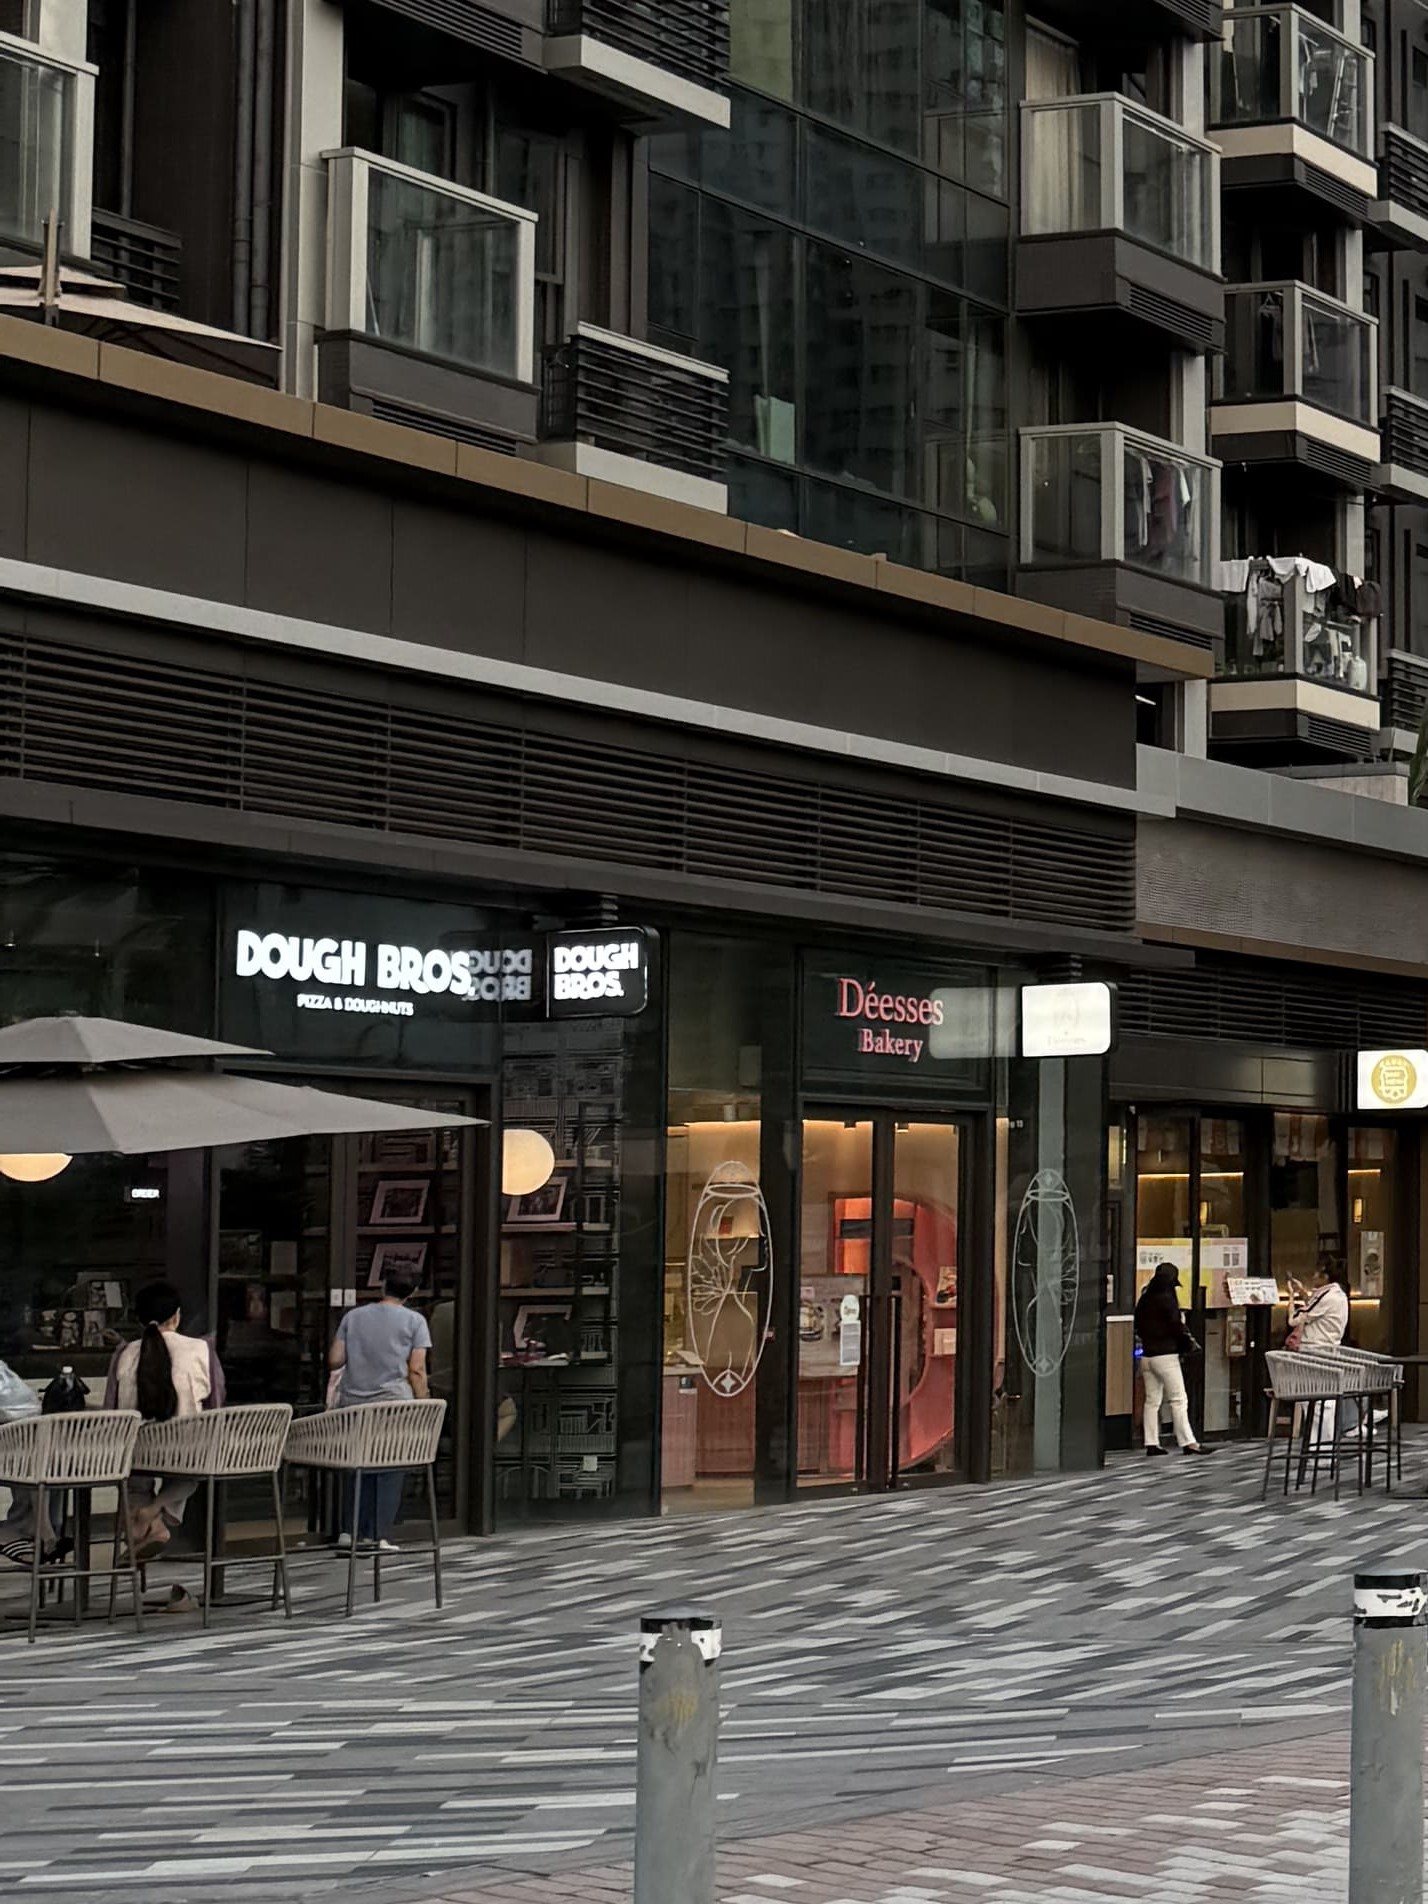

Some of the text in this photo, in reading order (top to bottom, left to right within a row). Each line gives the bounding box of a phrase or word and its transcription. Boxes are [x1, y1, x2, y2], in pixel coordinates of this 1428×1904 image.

[236, 930, 476, 996] DOUGH BROS.
[554, 942, 639, 973] DOUGH
[554, 972, 624, 1000] BROS.
[838, 977, 943, 1025] Déesses
[297, 993, 332, 1009] PIZZA
[344, 997, 414, 1016] DOUGHNUTS
[858, 1028, 923, 1063] Bakery
